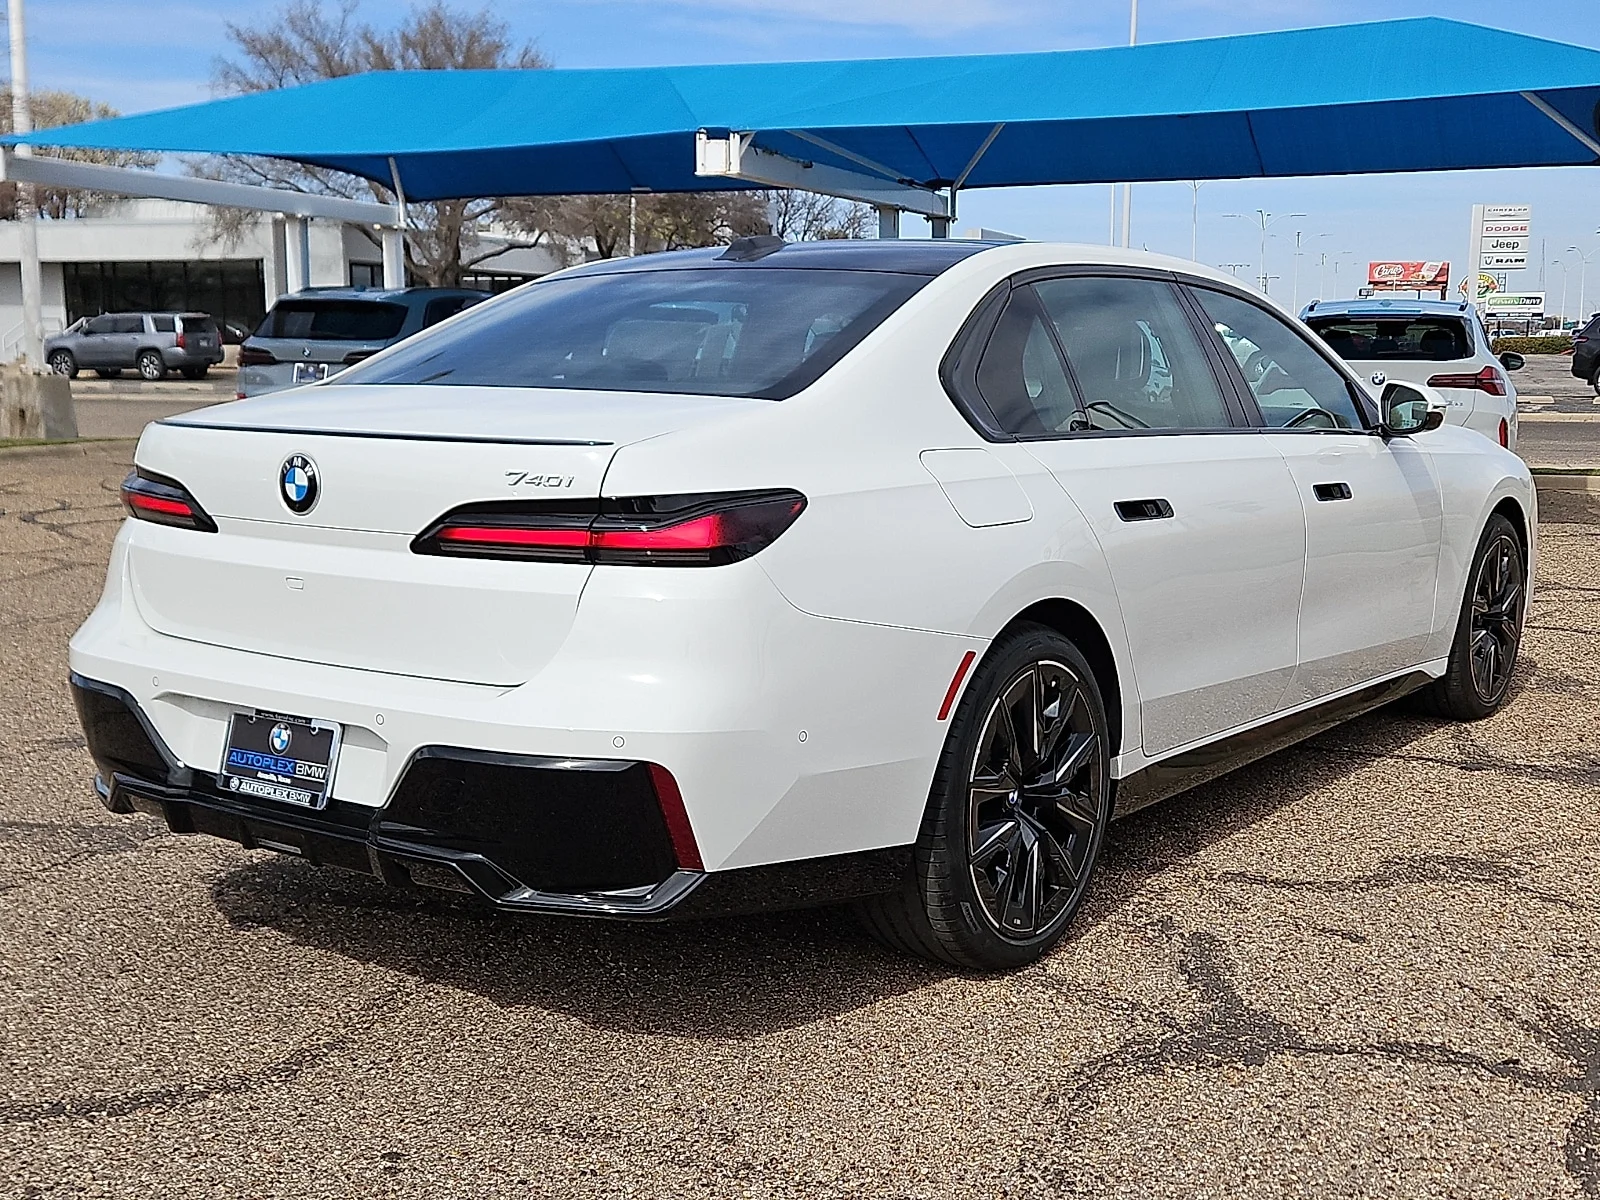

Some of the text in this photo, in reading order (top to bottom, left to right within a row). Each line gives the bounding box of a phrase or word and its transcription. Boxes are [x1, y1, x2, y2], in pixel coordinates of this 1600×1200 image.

[1491, 239, 1520, 251] Jeep
[229, 751, 326, 779] AUTOPLEX BMW
[239, 781, 311, 803] AUTOPLEX BMW
